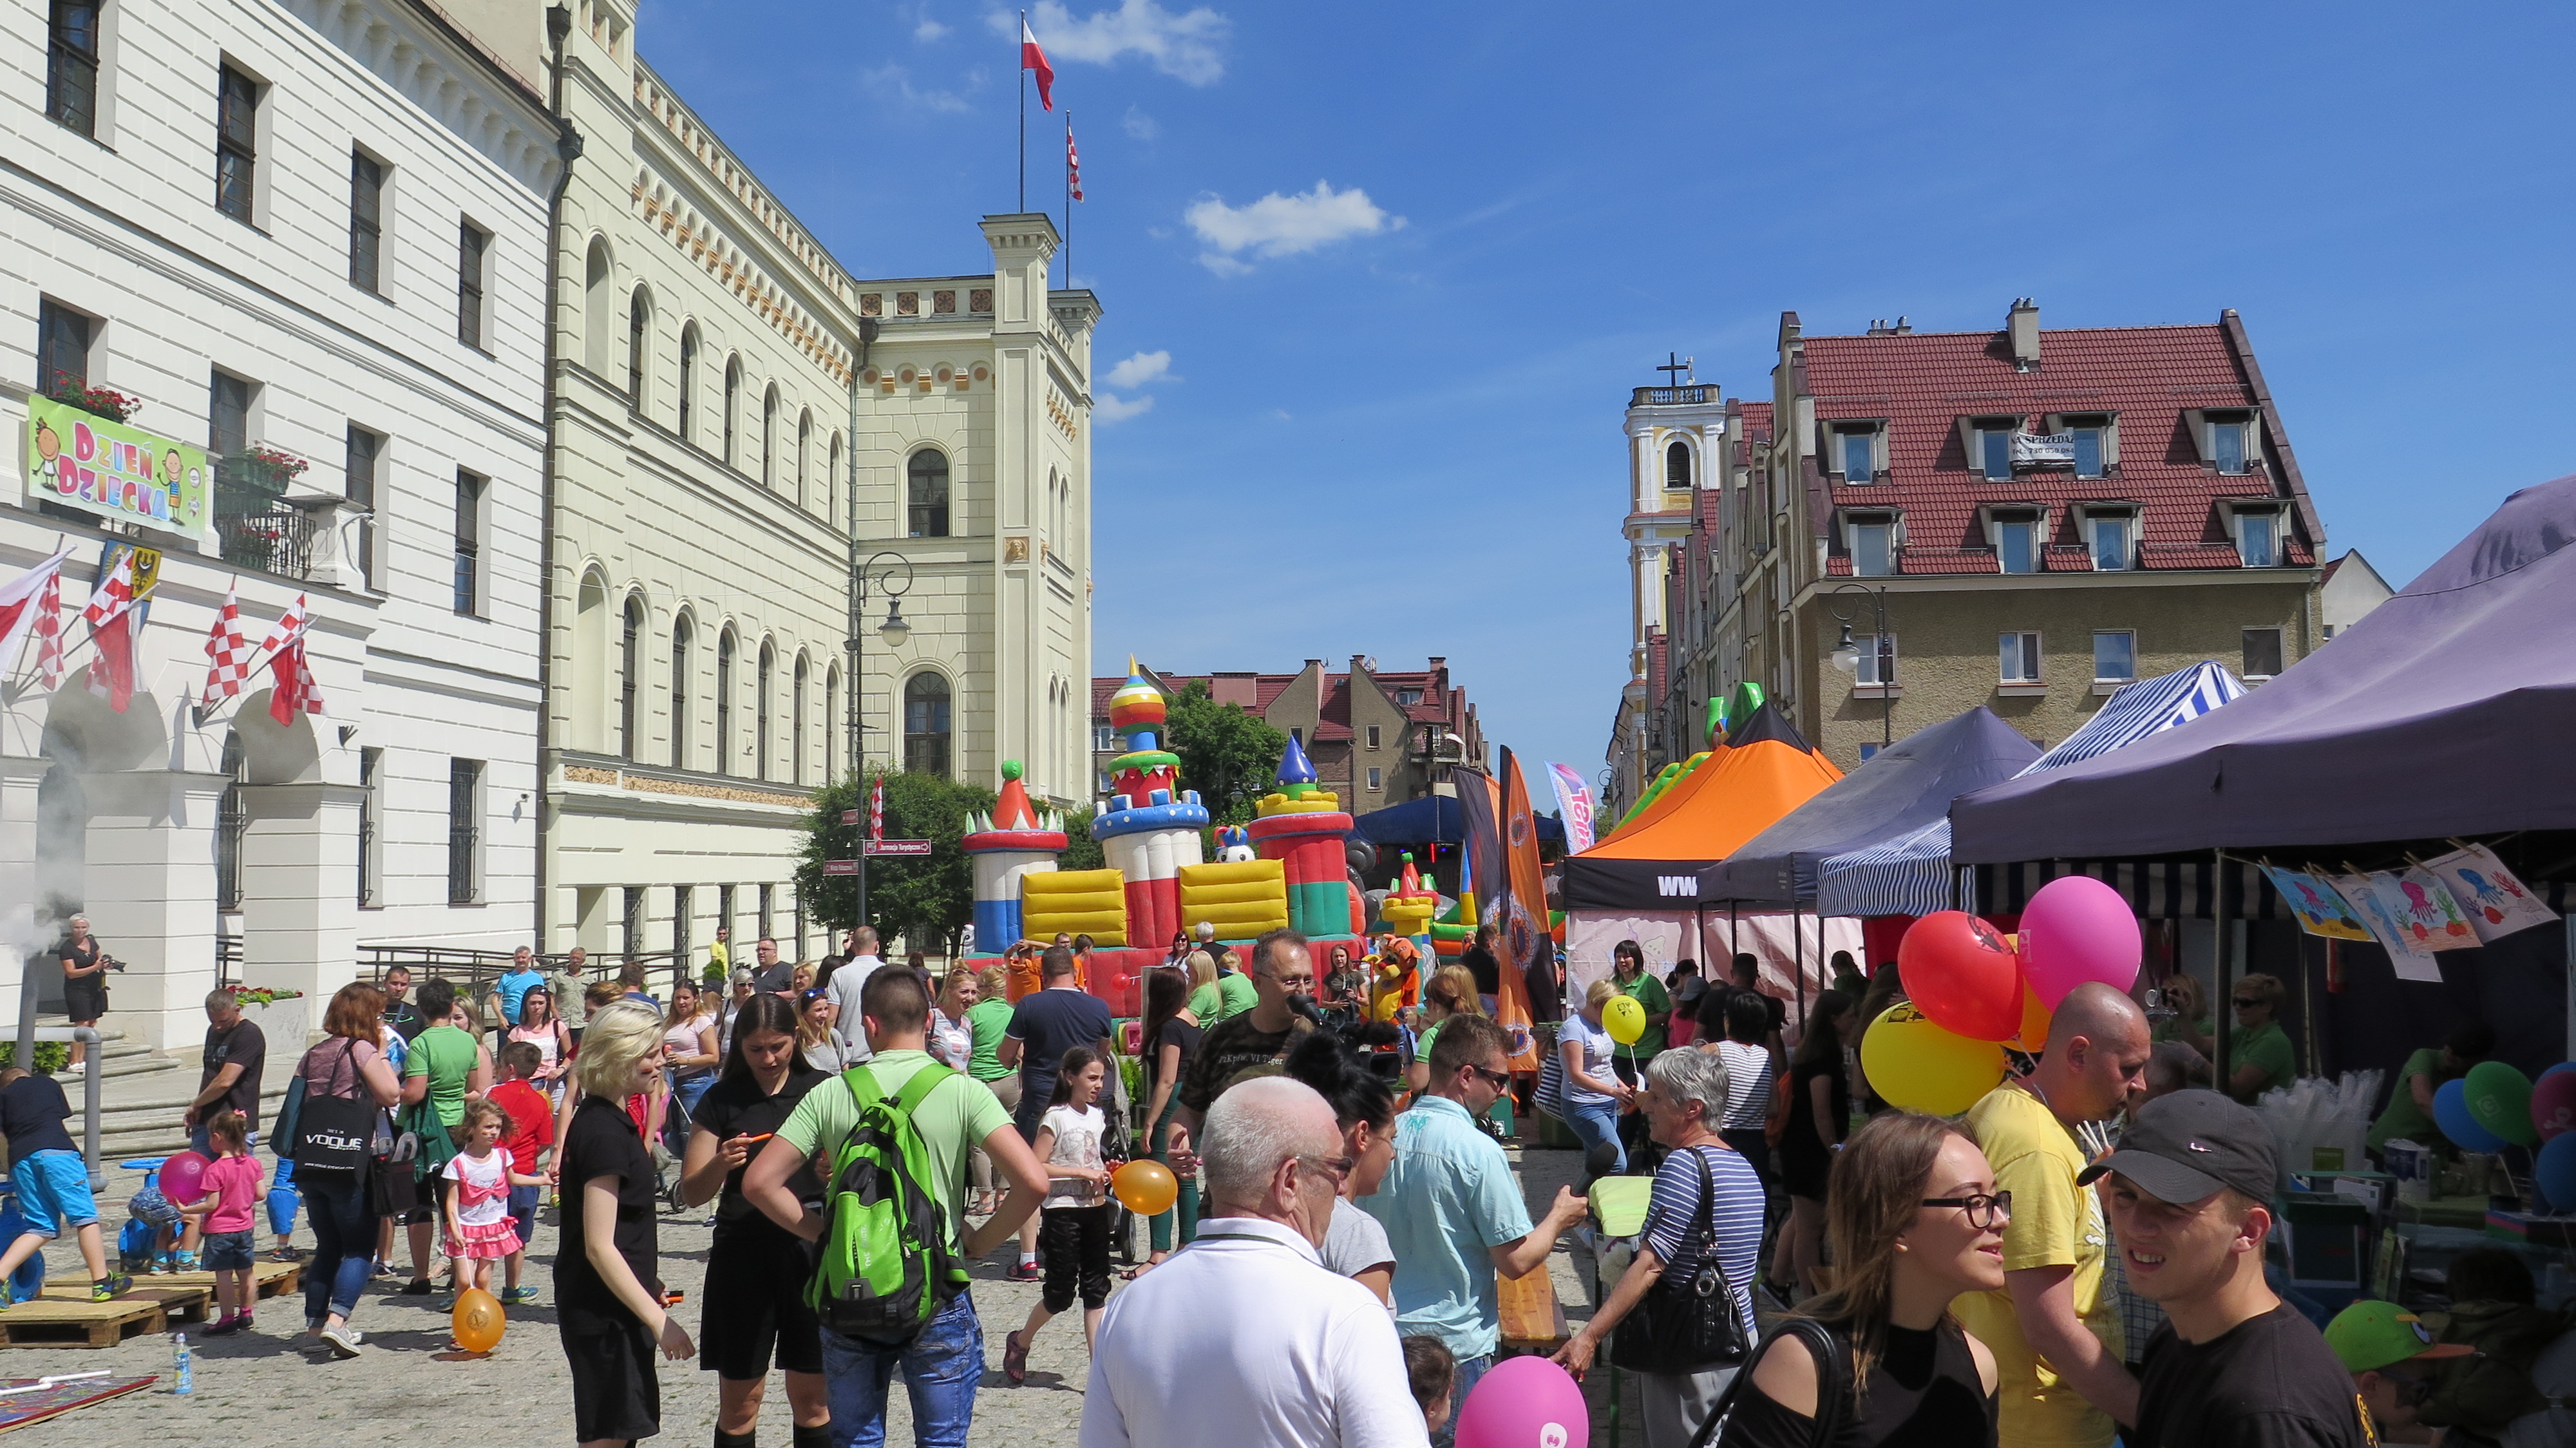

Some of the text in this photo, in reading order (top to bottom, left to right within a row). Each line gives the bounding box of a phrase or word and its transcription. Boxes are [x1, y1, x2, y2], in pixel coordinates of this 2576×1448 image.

[74, 422, 153, 481] DZIEŃ
[59, 453, 169, 520] DZIECKA
[1251, 1053, 1260, 1062] VI
